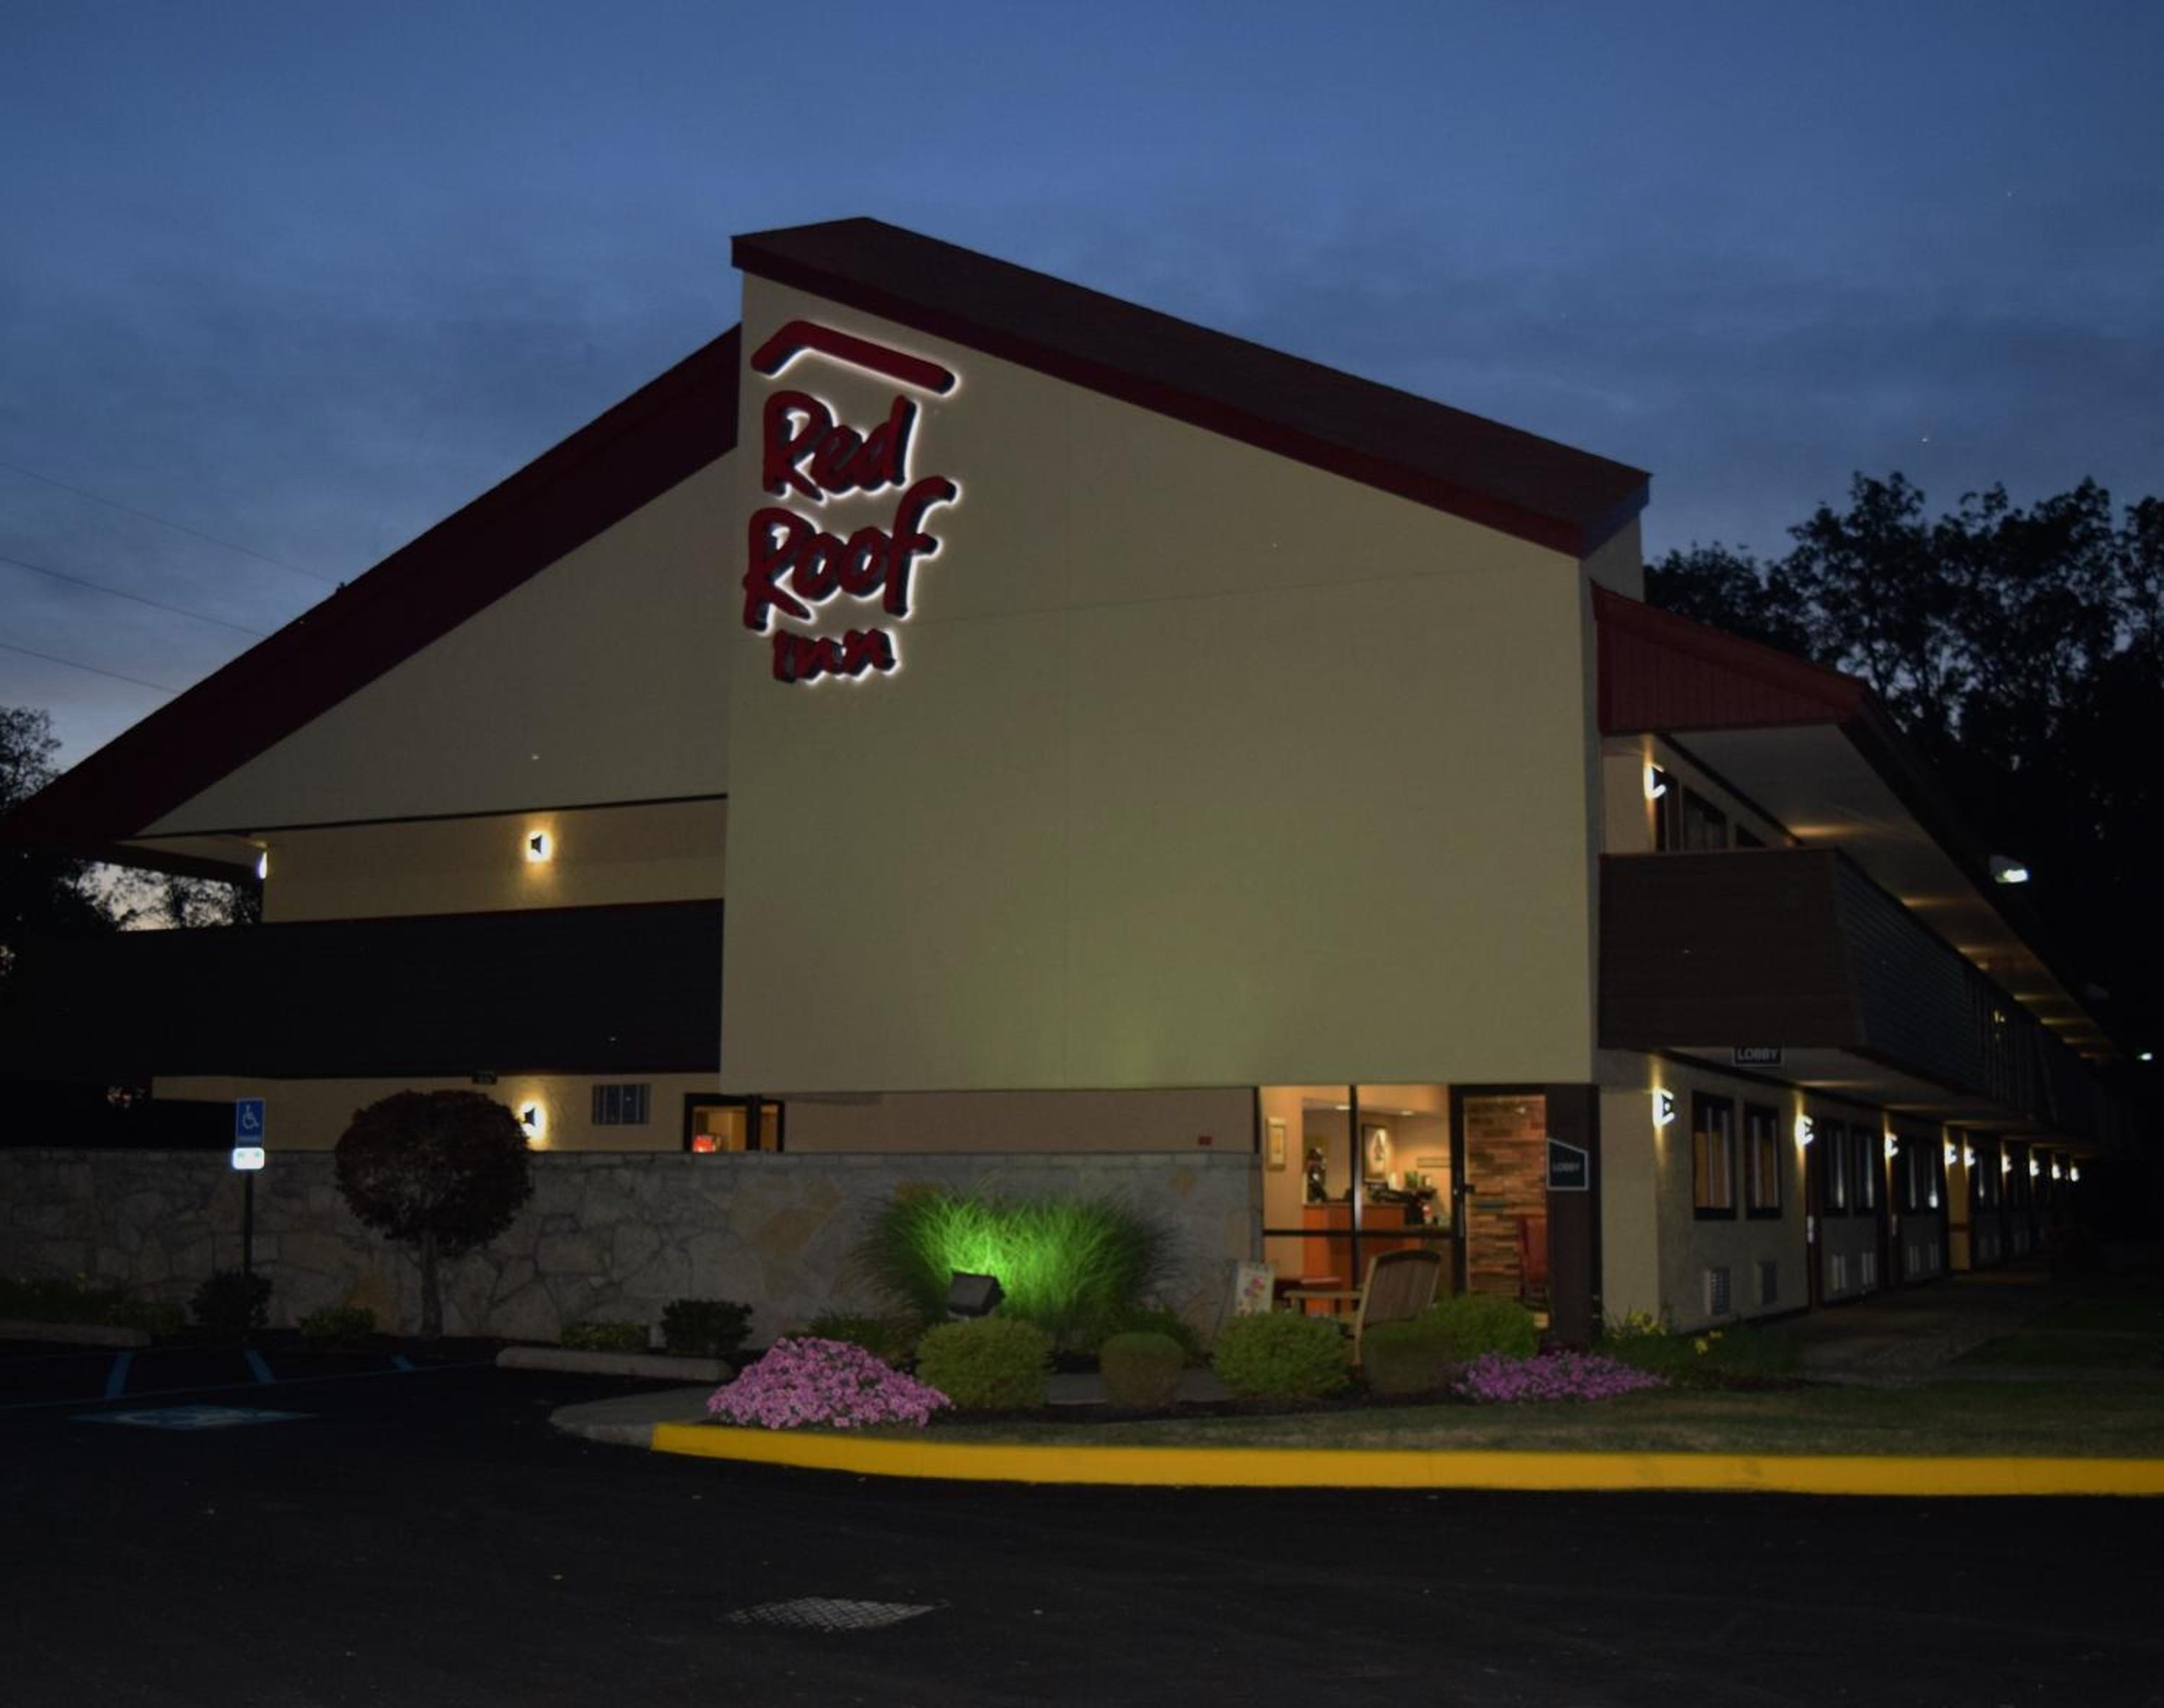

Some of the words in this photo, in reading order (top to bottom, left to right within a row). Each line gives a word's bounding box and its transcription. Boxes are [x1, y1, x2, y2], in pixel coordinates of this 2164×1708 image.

[762, 390, 918, 501] Red
[743, 476, 956, 632] Roof
[1736, 1047, 1779, 1061] LOBBY
[1552, 1162, 1581, 1174] LOBBY
